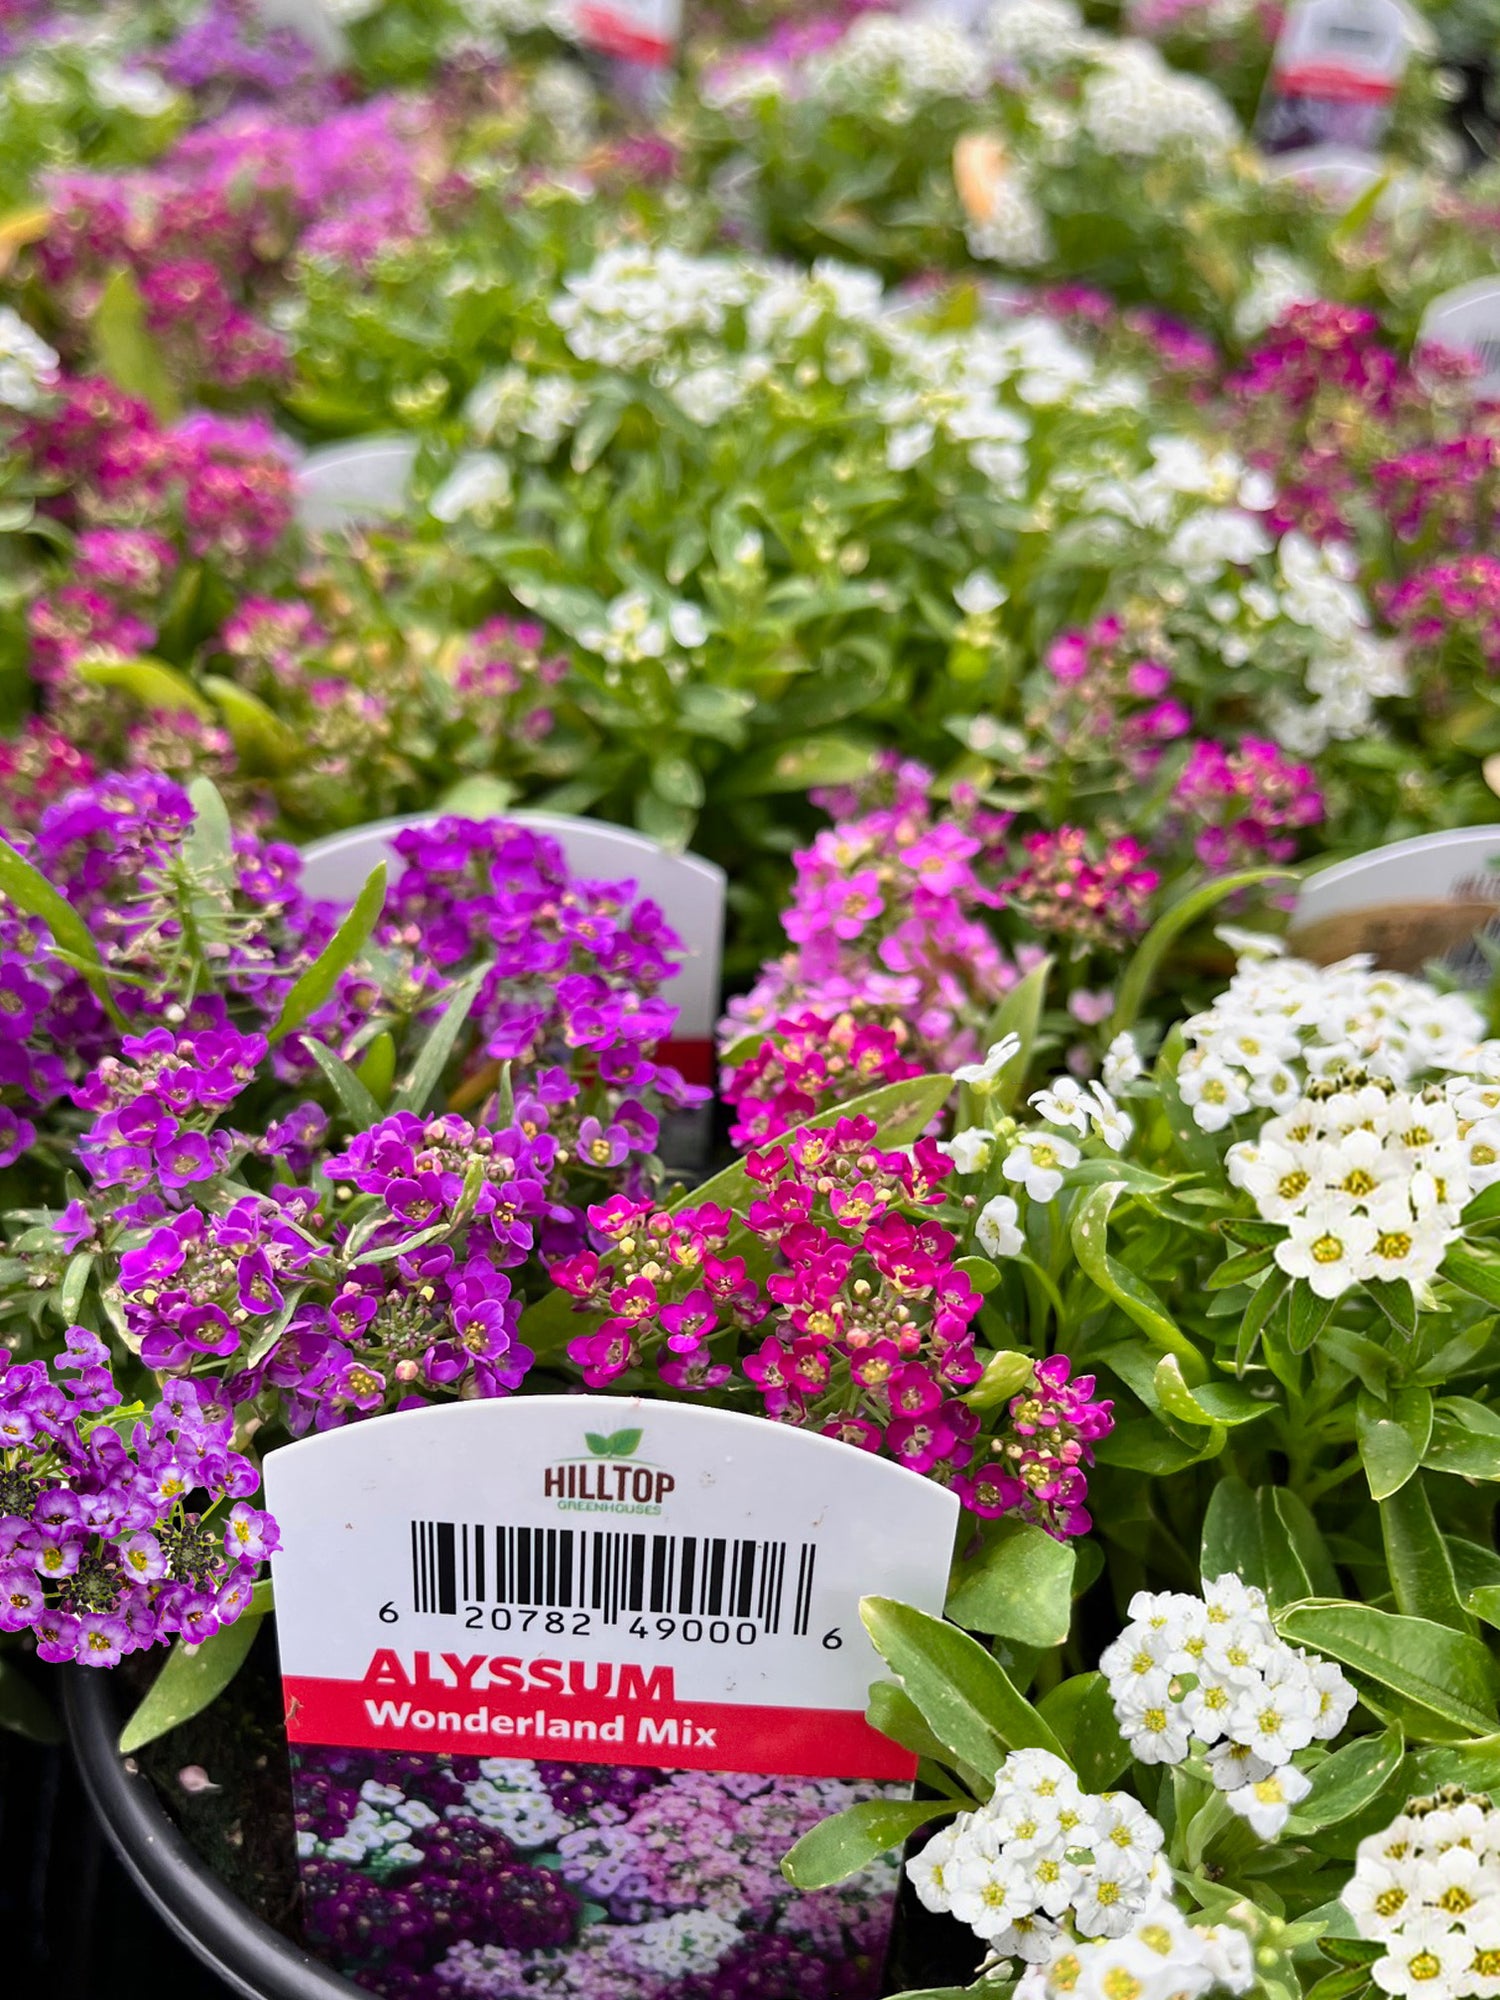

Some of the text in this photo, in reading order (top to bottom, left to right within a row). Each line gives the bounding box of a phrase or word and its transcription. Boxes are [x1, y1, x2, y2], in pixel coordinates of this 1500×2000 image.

[544, 1464, 675, 1503] HILLTOP
[557, 1499, 662, 1515] GREENHOUSES
[378, 1601, 843, 1650] 6 20782 49000 6
[363, 1648, 674, 1701] ALYSSUM
[364, 1700, 718, 1748] Wonderland Mix
